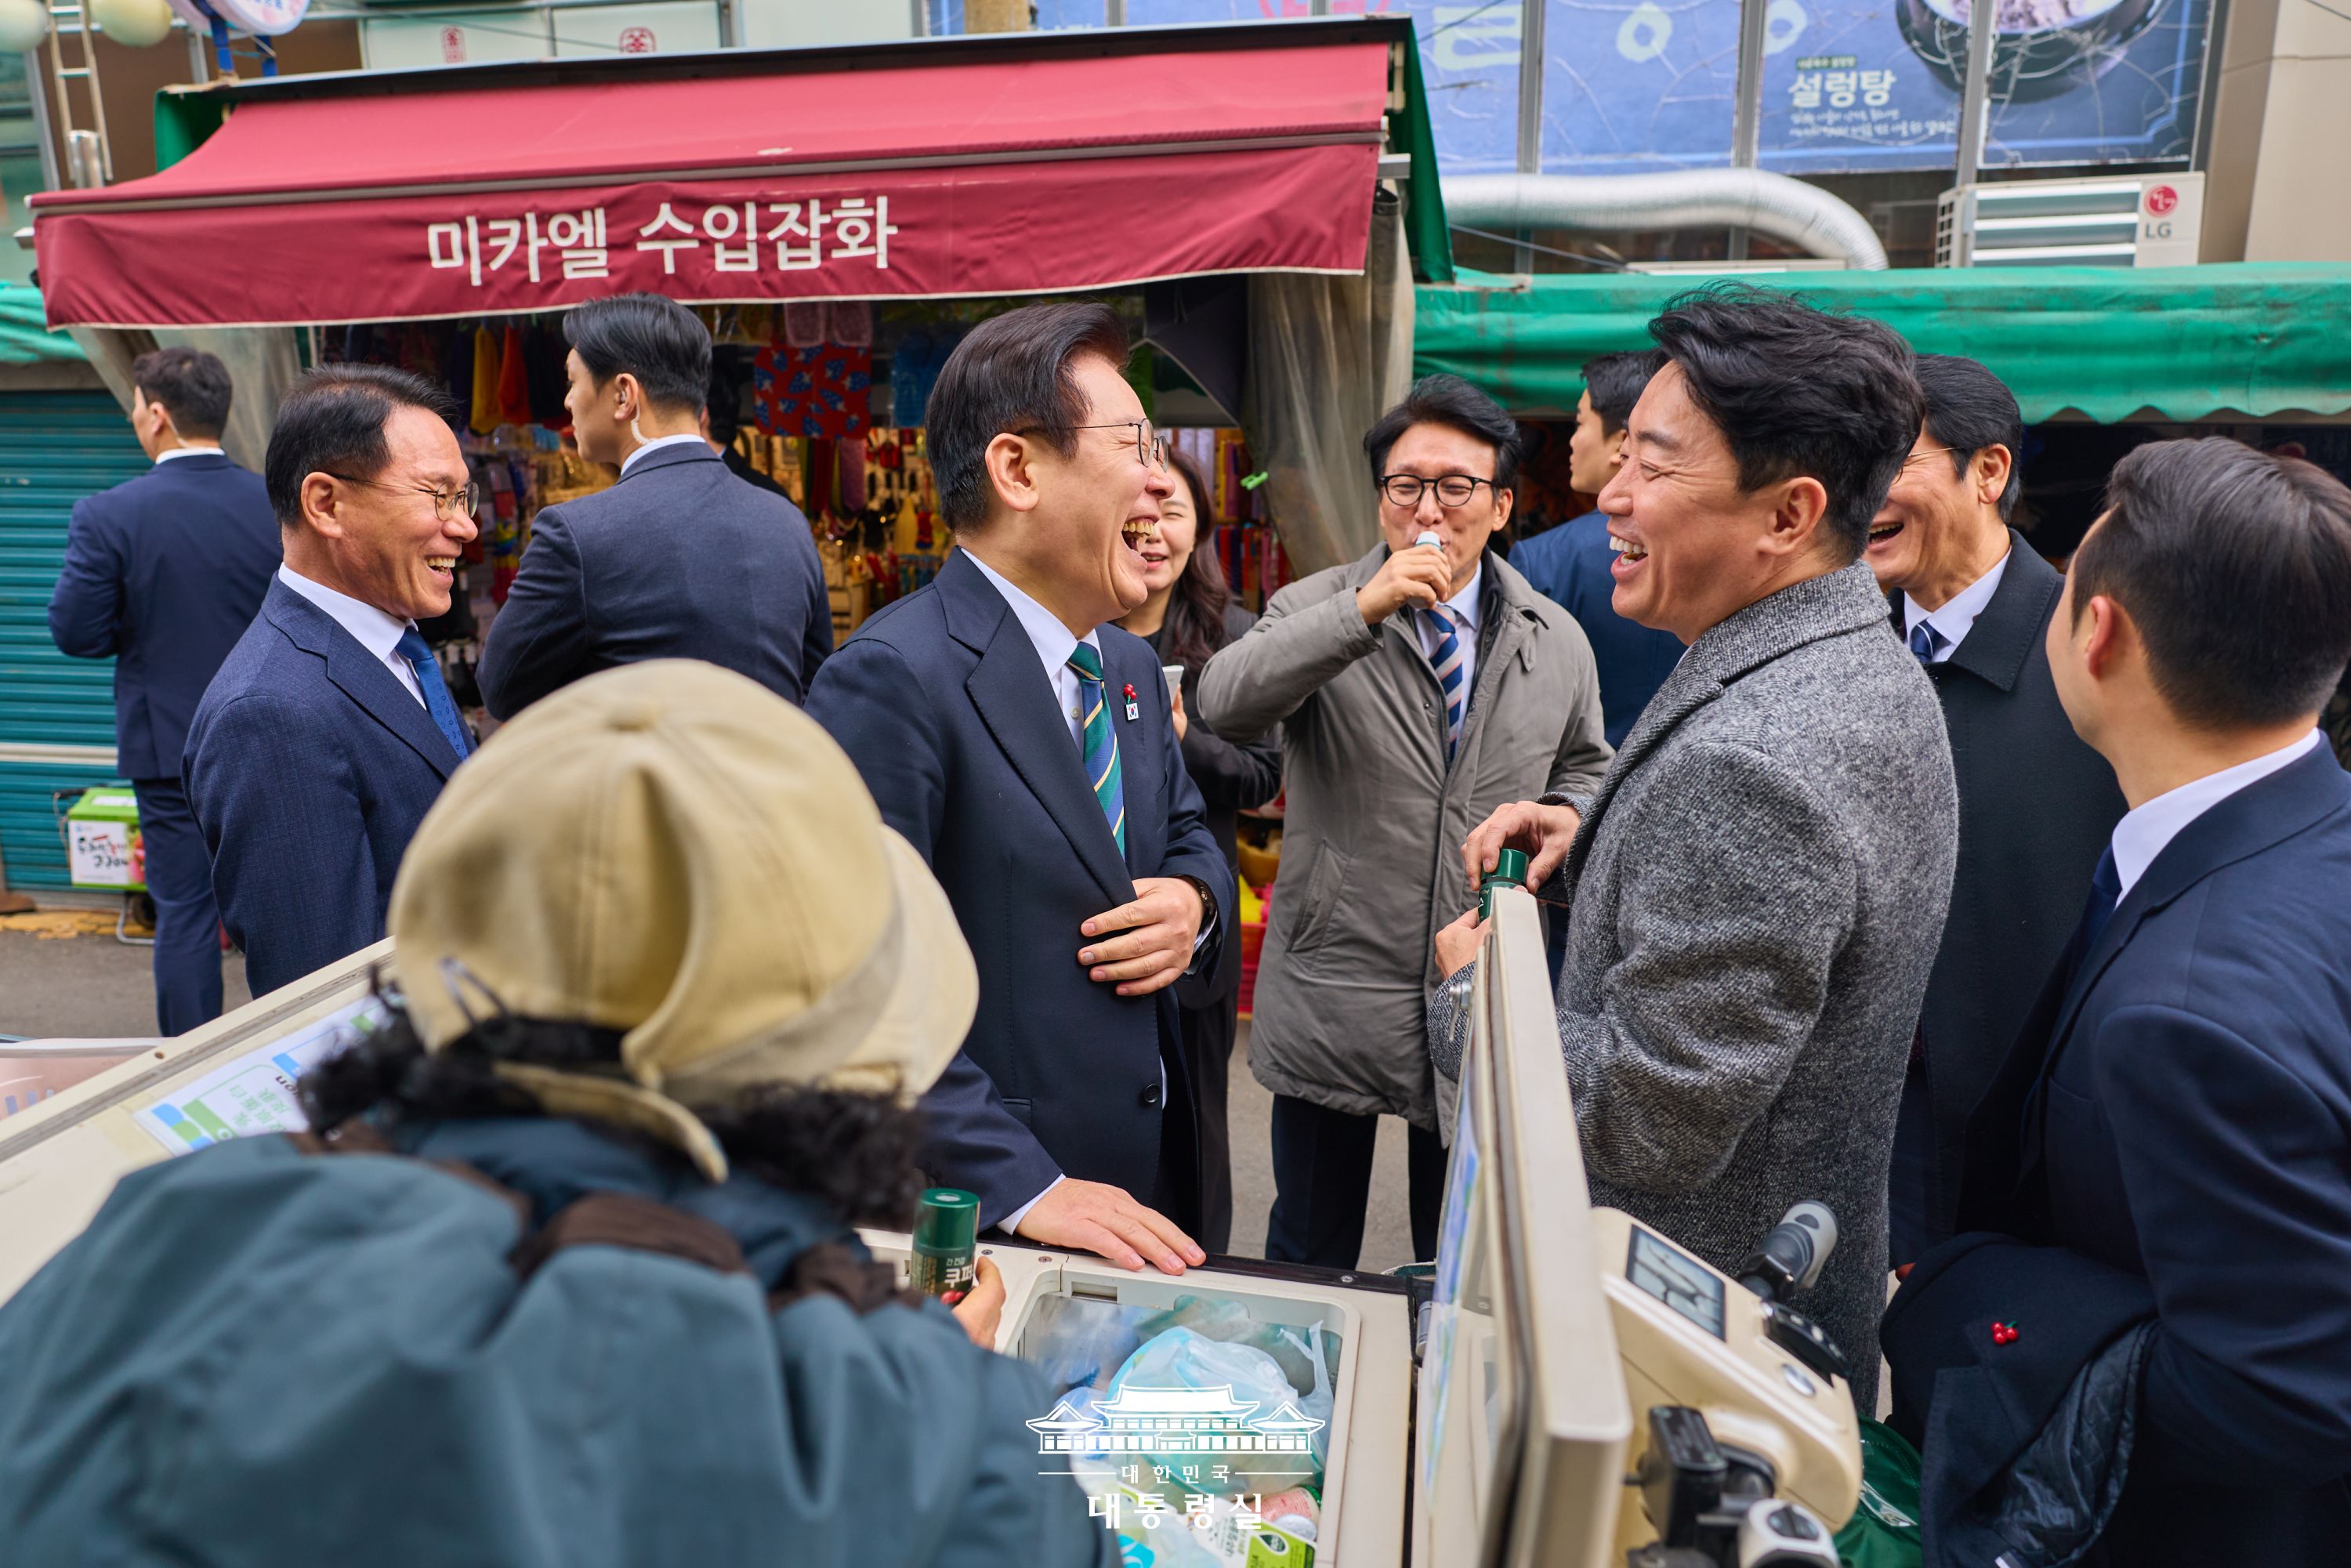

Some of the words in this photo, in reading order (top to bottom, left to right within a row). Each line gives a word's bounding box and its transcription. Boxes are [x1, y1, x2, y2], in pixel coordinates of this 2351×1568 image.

[1788, 70, 1896, 108] 설렁탕
[428, 208, 609, 286] 미카엘
[636, 196, 898, 274] 수입잡화
[2145, 222, 2172, 239] LG
